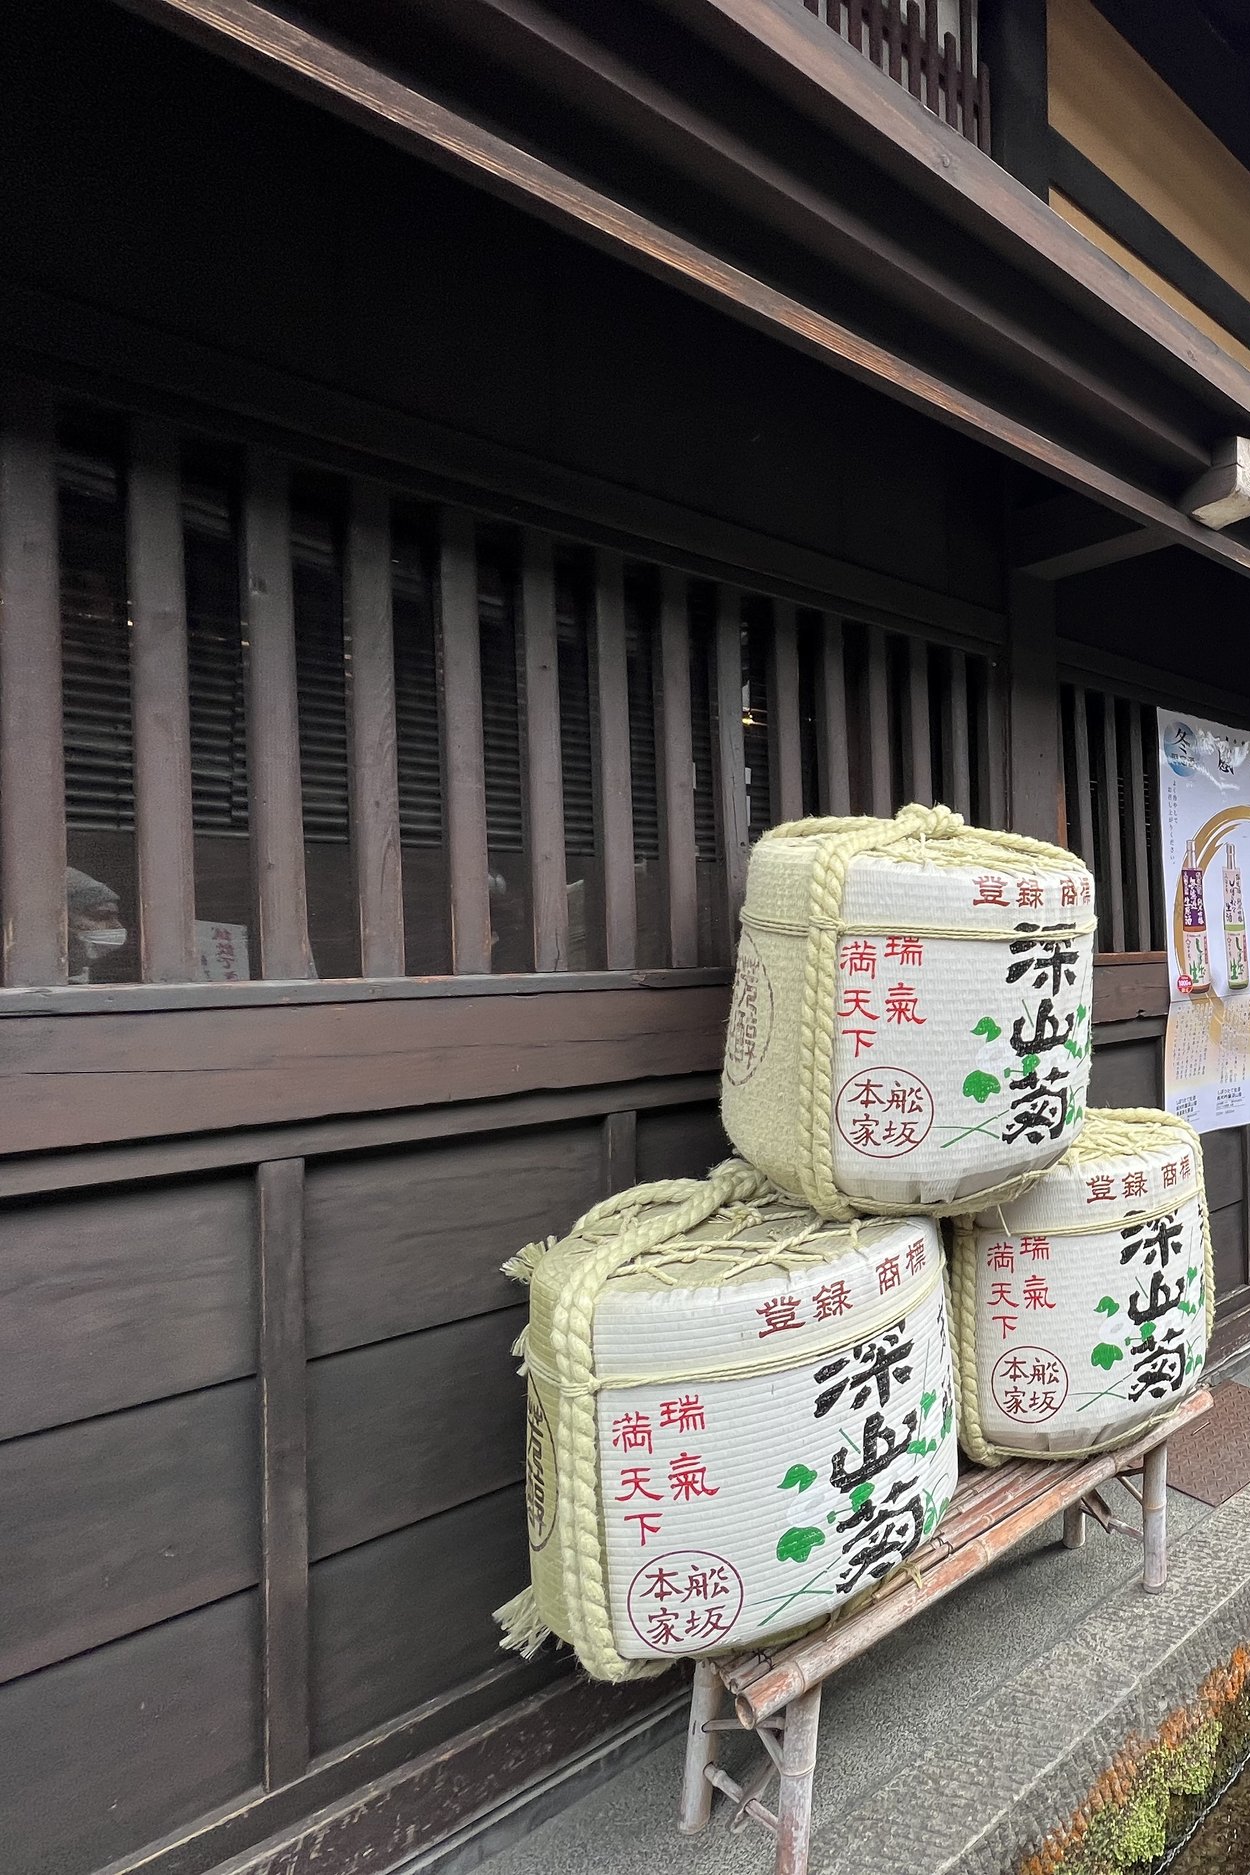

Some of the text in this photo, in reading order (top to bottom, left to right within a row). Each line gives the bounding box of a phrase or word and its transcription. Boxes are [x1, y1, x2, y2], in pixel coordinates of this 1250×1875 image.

[1174, 728, 1191, 754] 冬
[1002, 922, 1080, 1146] 深山菊
[756, 1237, 928, 1338] 登録商標
[1119, 1210, 1185, 1403] 深山菊
[611, 1411, 664, 1546] 満天下
[813, 1318, 926, 1595] 深山菊
